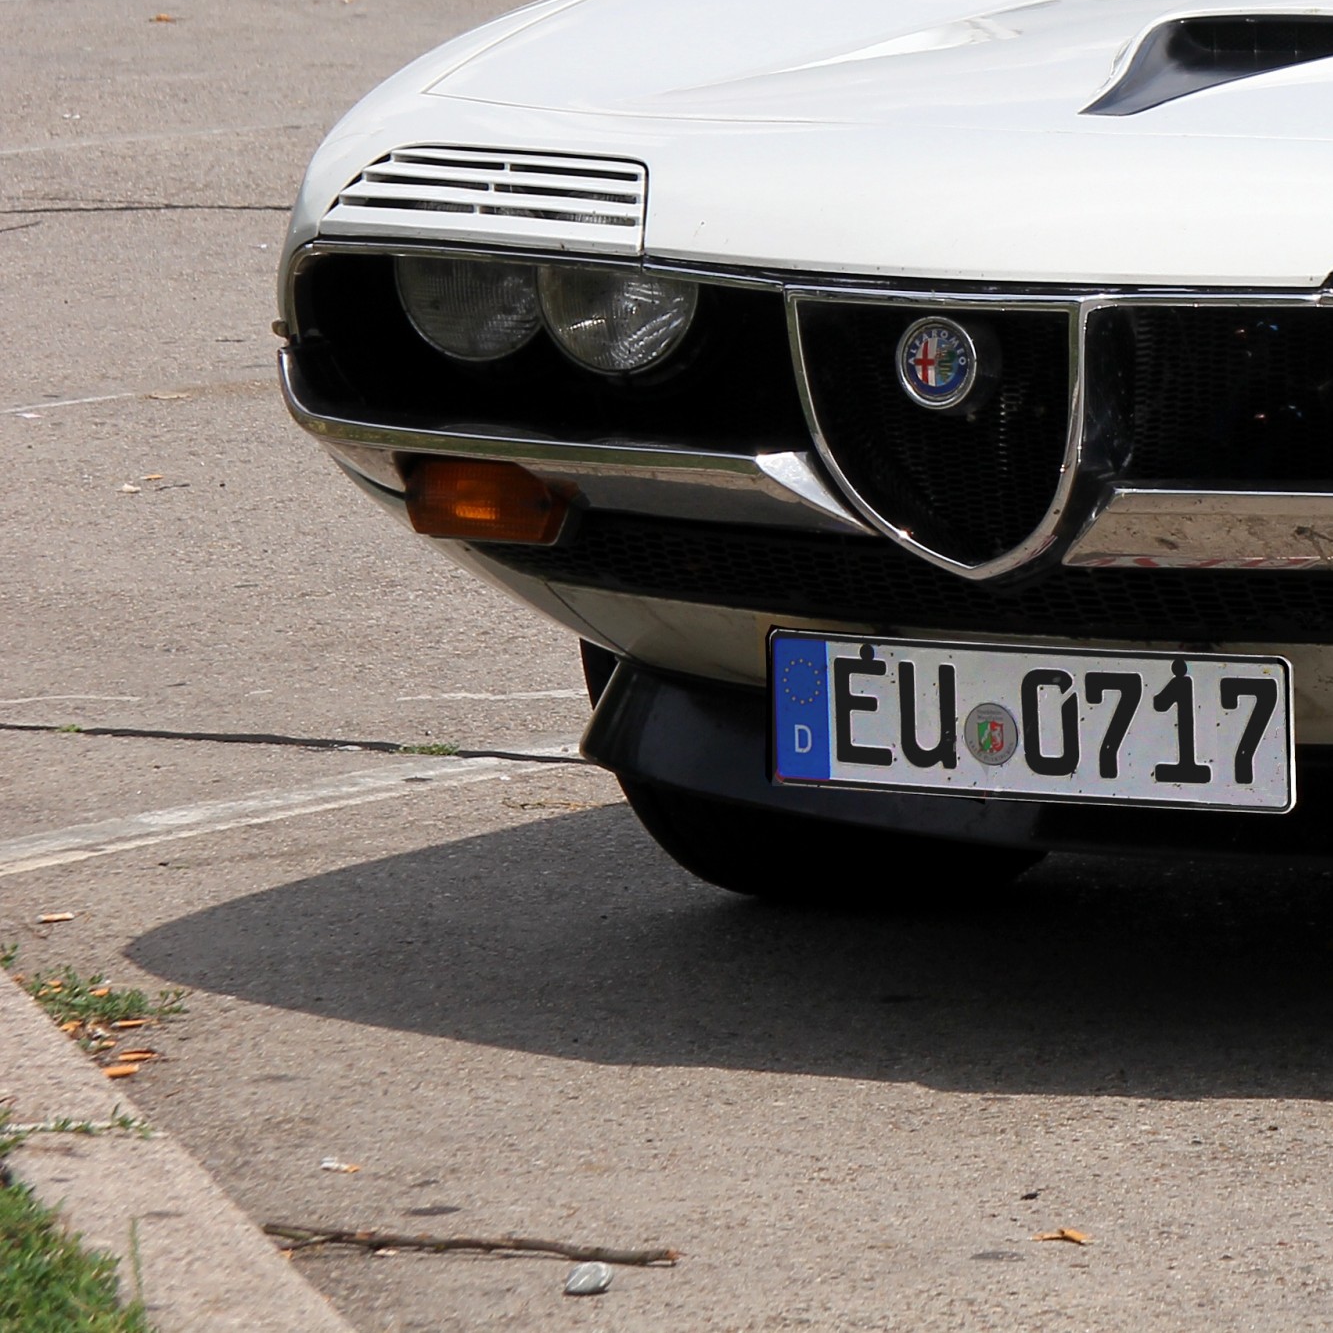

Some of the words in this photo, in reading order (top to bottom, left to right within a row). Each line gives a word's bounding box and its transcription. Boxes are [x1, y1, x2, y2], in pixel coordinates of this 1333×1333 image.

[794, 723, 813, 755] D
[832, 656, 959, 770] EU
[1020, 668, 1279, 786] 0717
